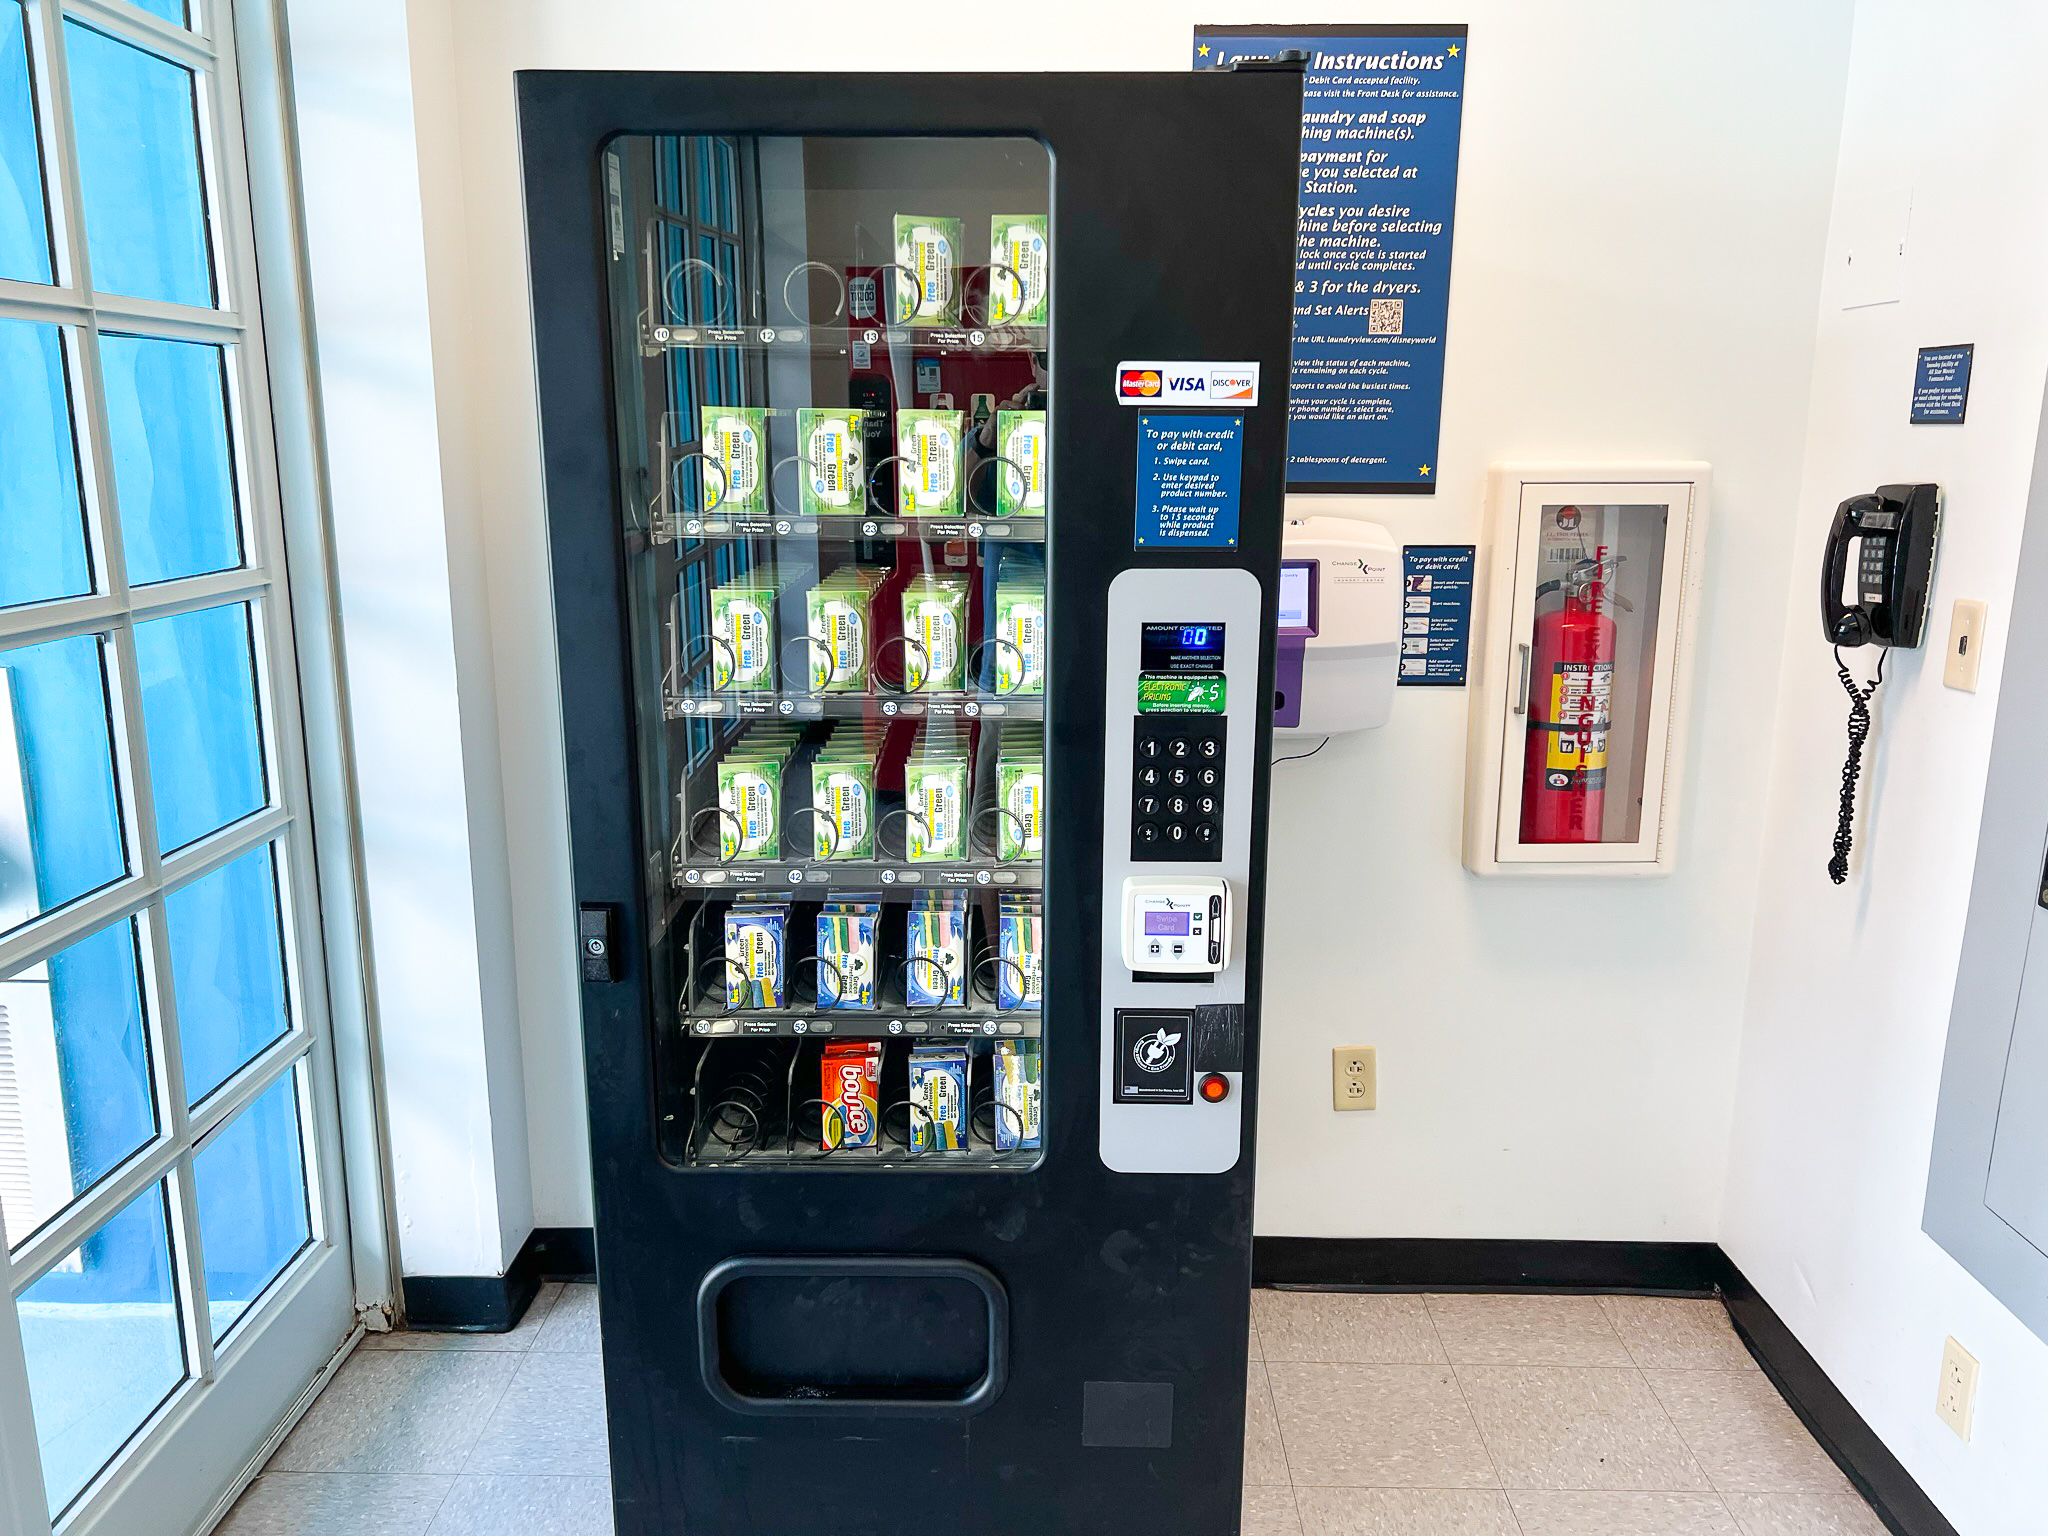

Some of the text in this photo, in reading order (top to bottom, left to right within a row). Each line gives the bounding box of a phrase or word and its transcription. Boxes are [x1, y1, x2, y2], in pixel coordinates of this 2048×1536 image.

[1314, 51, 1444, 70] Instructions
[1309, 76, 1420, 85] Debit Card accepted facility.
[1324, 89, 1340, 97] visit
[1342, 89, 1355, 97] the
[1381, 89, 1400, 97] Desk
[1402, 89, 1415, 99] for
[1358, 110, 1388, 123] and
[1390, 114, 1426, 127] soap
[1336, 126, 1414, 141] machine(s).
[1366, 150, 1388, 165] for
[1314, 164, 1418, 181] you selected at
[1304, 181, 1357, 193] Station.
[1335, 207, 1364, 220] you
[1368, 204, 1410, 217] desire
[1332, 219, 1442, 235] before selecting
[1320, 235, 1380, 247] machine.
[1300, 249, 1320, 259] lock
[1350, 249, 1374, 261] cycle
[1378, 250, 1386, 259] is
[1389, 250, 1426, 260] started
[926, 242, 935, 302] Free Green
[1308, 260, 1415, 272] until cycle completes.
[1309, 281, 1318, 293] 3
[1321, 280, 1343, 295] for
[1347, 280, 1368, 293] the
[1373, 280, 1420, 295] dryers.
[1314, 305, 1369, 315] Set Alerts
[762, 331, 773, 339] 12
[866, 332, 877, 341] 13
[972, 333, 983, 342] 15
[1327, 336, 1436, 344] laundryview.com/disneyworld
[1122, 378, 1160, 388] MasterCard
[1168, 377, 1205, 391] VISA
[1146, 429, 1234, 440] To pay with credit
[1170, 441, 1195, 450] debit
[1198, 441, 1222, 451] card,
[826, 433, 836, 491] Free Green
[1164, 457, 1187, 466] Swipe
[1179, 473, 1209, 483] keypad
[1161, 489, 1227, 498] product number.
[1162, 505, 1187, 514] Please
[778, 523, 790, 532] 22
[865, 524, 876, 533] 23
[971, 526, 982, 534] 25
[1160, 521, 1214, 530] while product
[1168, 529, 1209, 537] dispensed.
[742, 614, 751, 669] Free Green
[965, 705, 977, 713] 35
[1148, 742, 1155, 756] 1
[1176, 742, 1185, 756] 2
[1205, 742, 1214, 756] 3
[1145, 770, 1154, 784] 4
[1174, 770, 1184, 784] 5
[1204, 770, 1214, 784] 6
[1145, 798, 1154, 812] 7
[1174, 798, 1183, 812] 8
[1203, 798, 1213, 812] 9
[1173, 826, 1182, 840] 0
[840, 1065, 867, 1134] bounce
